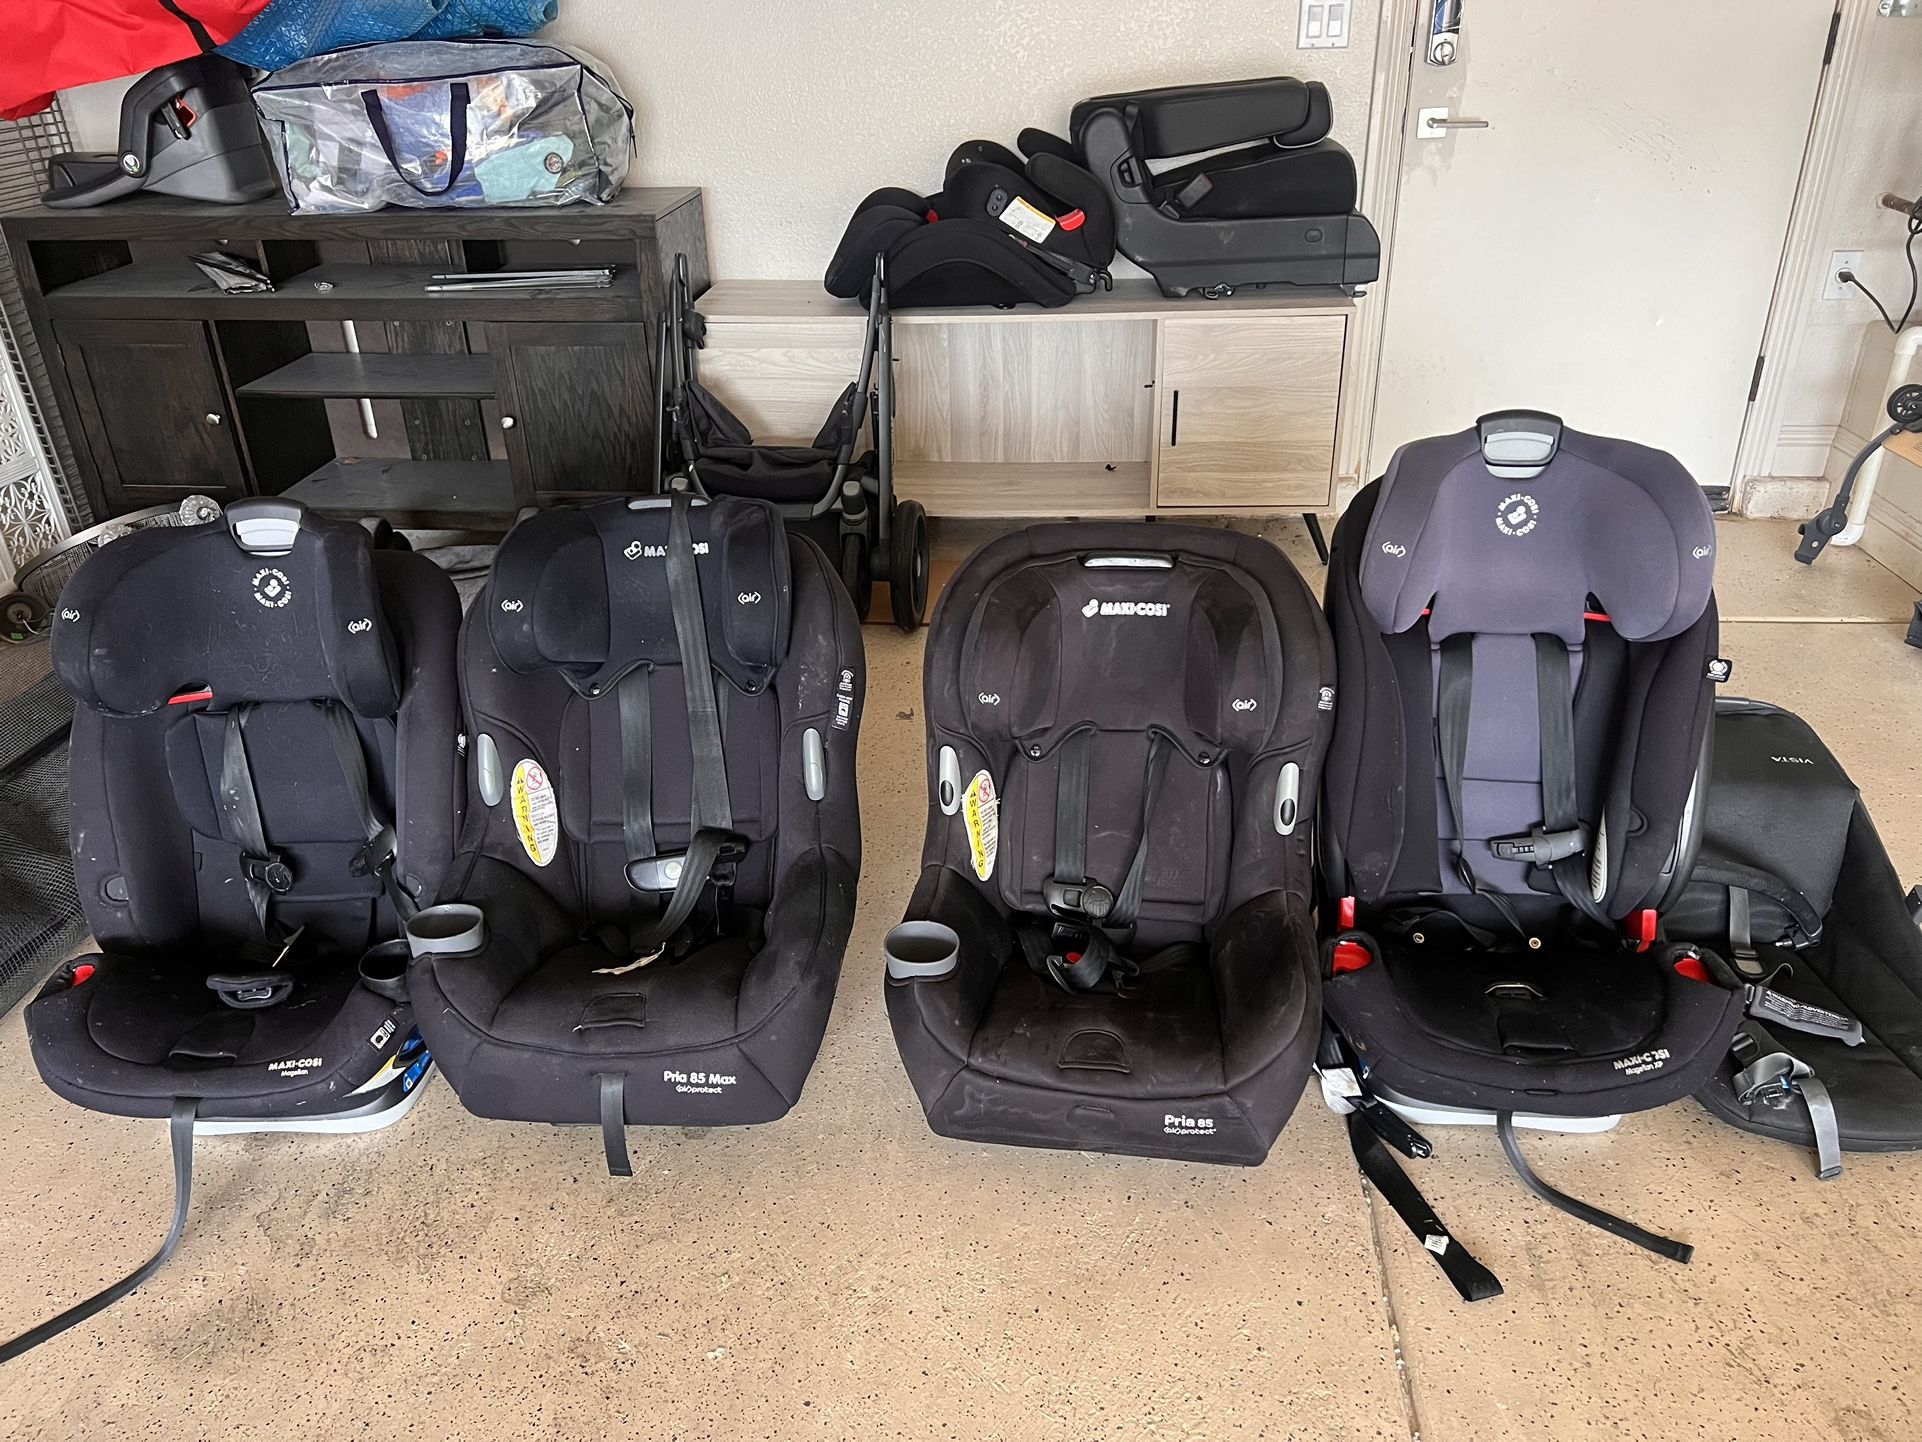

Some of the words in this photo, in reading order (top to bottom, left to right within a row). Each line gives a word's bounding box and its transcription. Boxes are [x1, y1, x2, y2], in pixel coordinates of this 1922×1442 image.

[1770, 756, 1815, 765] VISTA
[516, 786, 538, 853] WARNING
[968, 800, 986, 869] WARNING
[663, 1070, 688, 1083] Pria
[689, 1072, 706, 1084] 85
[708, 1073, 737, 1085] Max
[1164, 1114, 1196, 1127] Pria
[1197, 1118, 1214, 1128] 85
